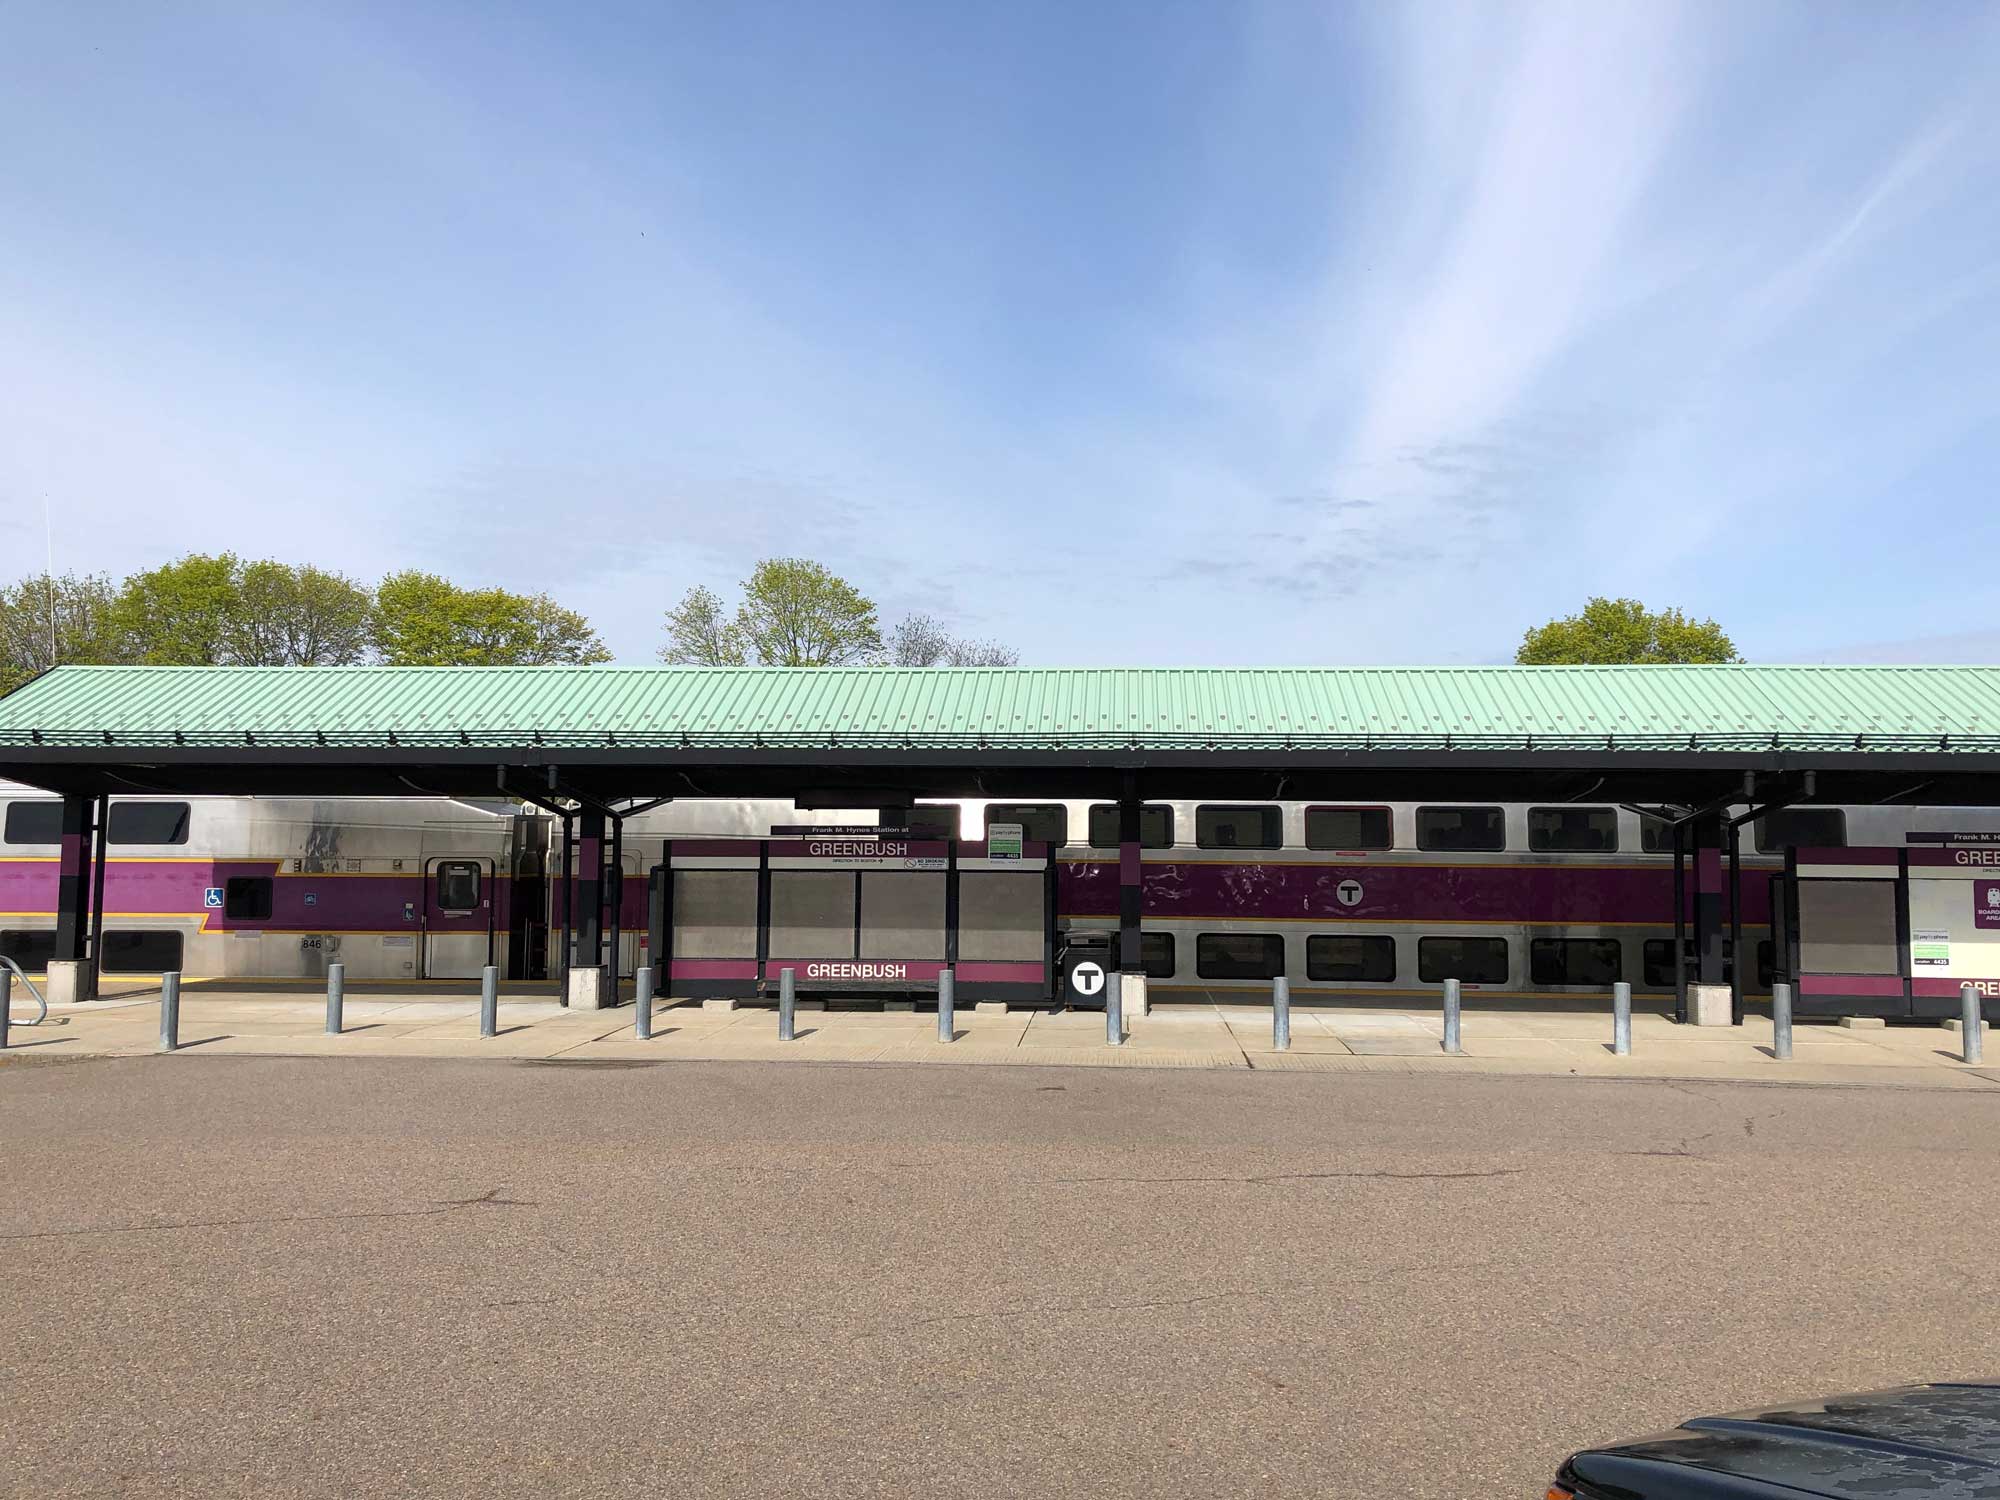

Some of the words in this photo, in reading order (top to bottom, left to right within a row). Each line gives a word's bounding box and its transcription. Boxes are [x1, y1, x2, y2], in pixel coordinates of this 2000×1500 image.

[809, 842, 907, 856] GREENBUSH
[303, 939, 322, 949] 846
[807, 963, 906, 978] GREENBUSH
[1959, 981, 2000, 996] RE
